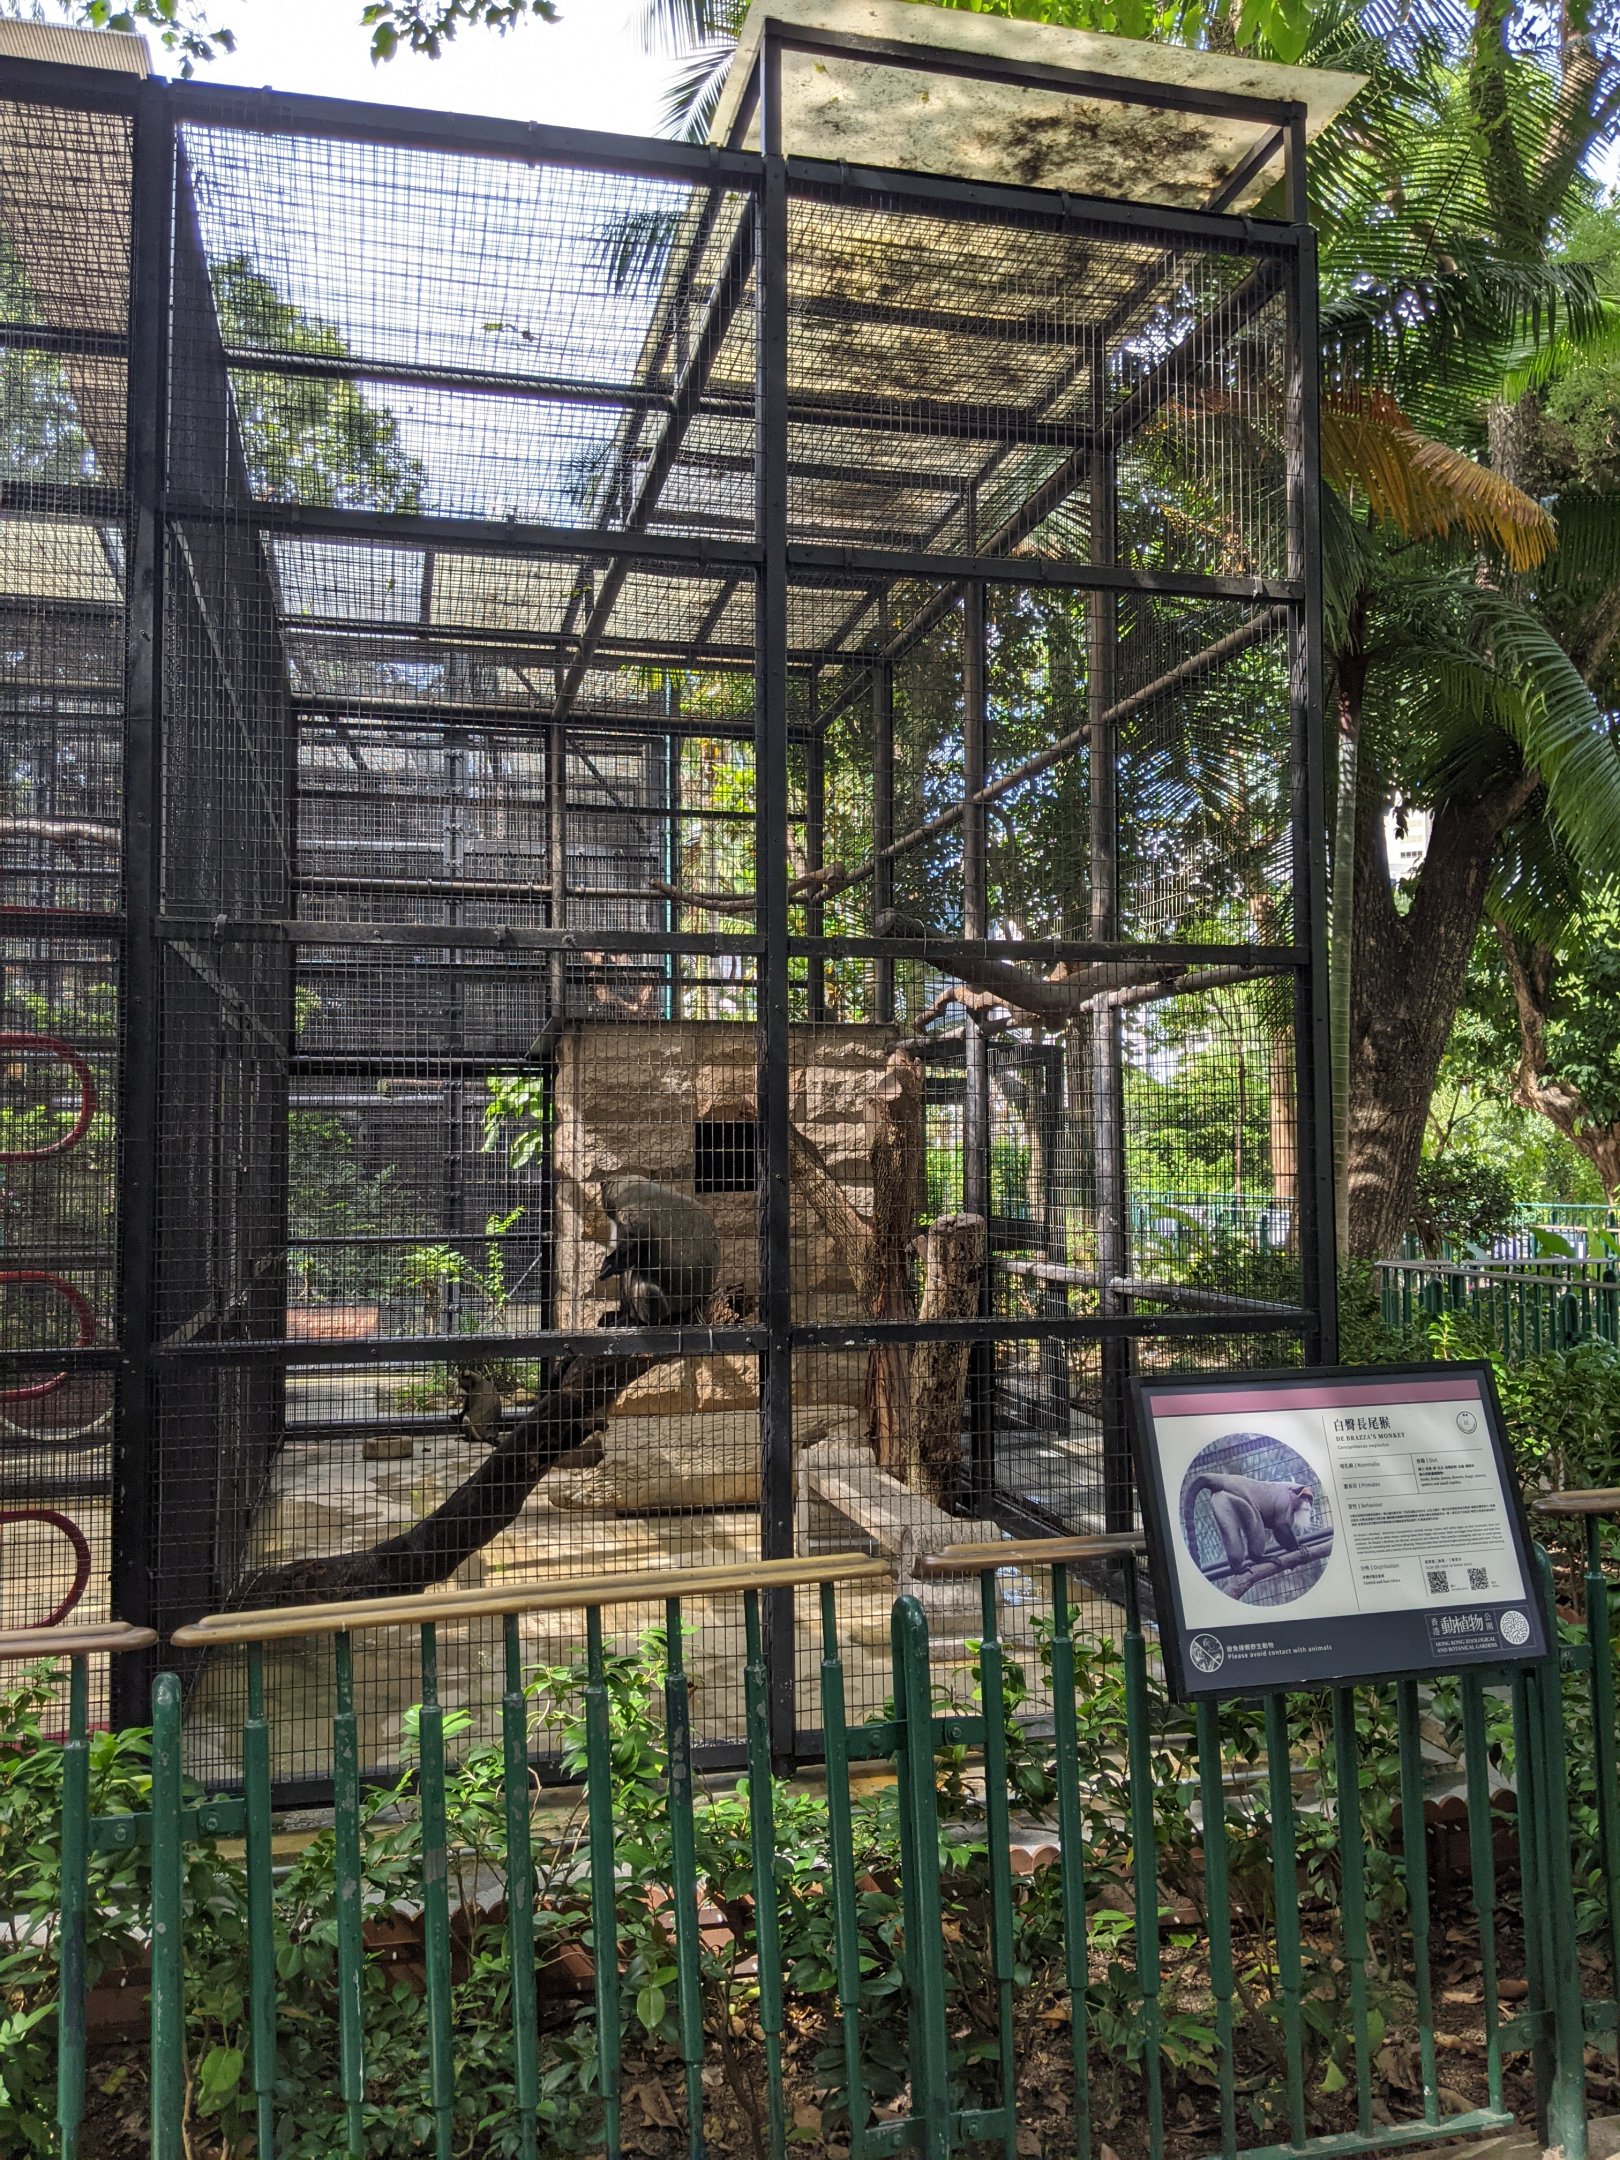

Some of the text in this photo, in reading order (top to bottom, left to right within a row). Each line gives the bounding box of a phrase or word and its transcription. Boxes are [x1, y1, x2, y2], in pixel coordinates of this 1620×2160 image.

[1334, 1416, 1391, 1432] 白臀長尾猴
[1346, 1433, 1376, 1442] BRAZZA'S
[1440, 1613, 1483, 1635] 動植物
[1466, 1636, 1496, 1644] ZOOLOGICAL
[1268, 1648, 1291, 1656] contact
[1293, 1646, 1307, 1654] with
[1308, 1644, 1333, 1653] animals
[1448, 1644, 1475, 1652] BOTANICAL
[1475, 1642, 1498, 1650] GARDENS
